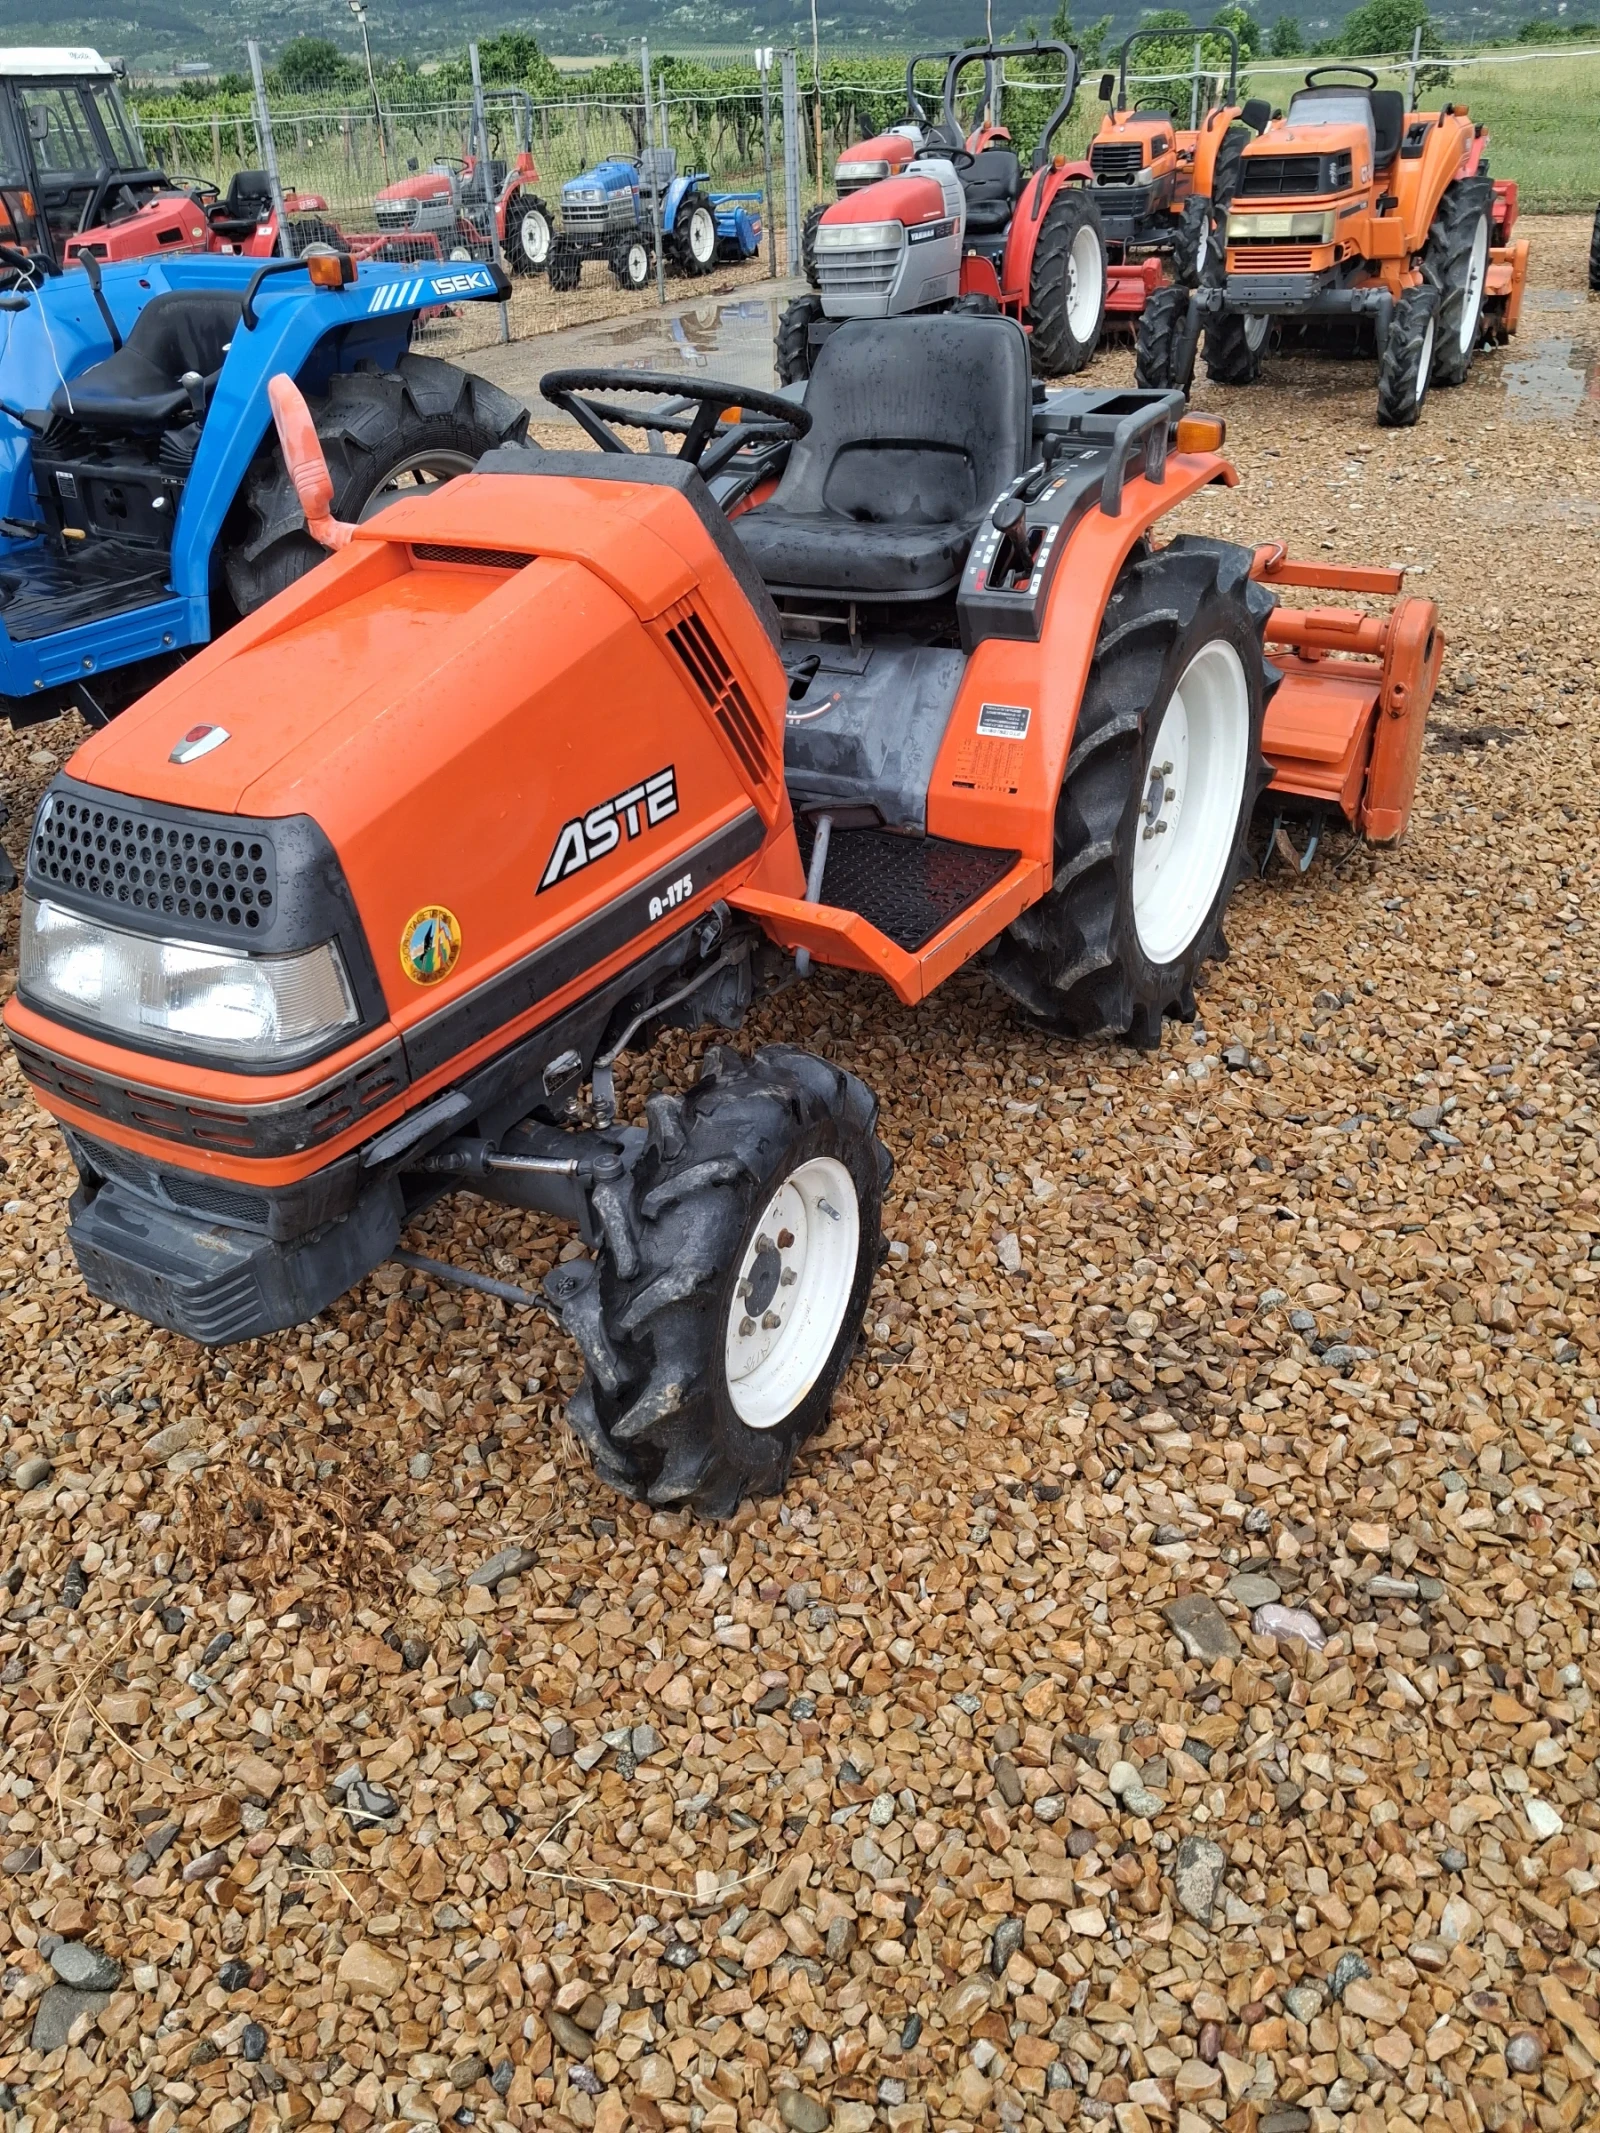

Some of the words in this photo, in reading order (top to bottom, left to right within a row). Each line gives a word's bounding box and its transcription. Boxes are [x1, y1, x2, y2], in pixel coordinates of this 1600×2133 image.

[430, 271, 492, 295] ISEKI
[537, 766, 679, 892] ASTE
[648, 872, 693, 921] A-175
